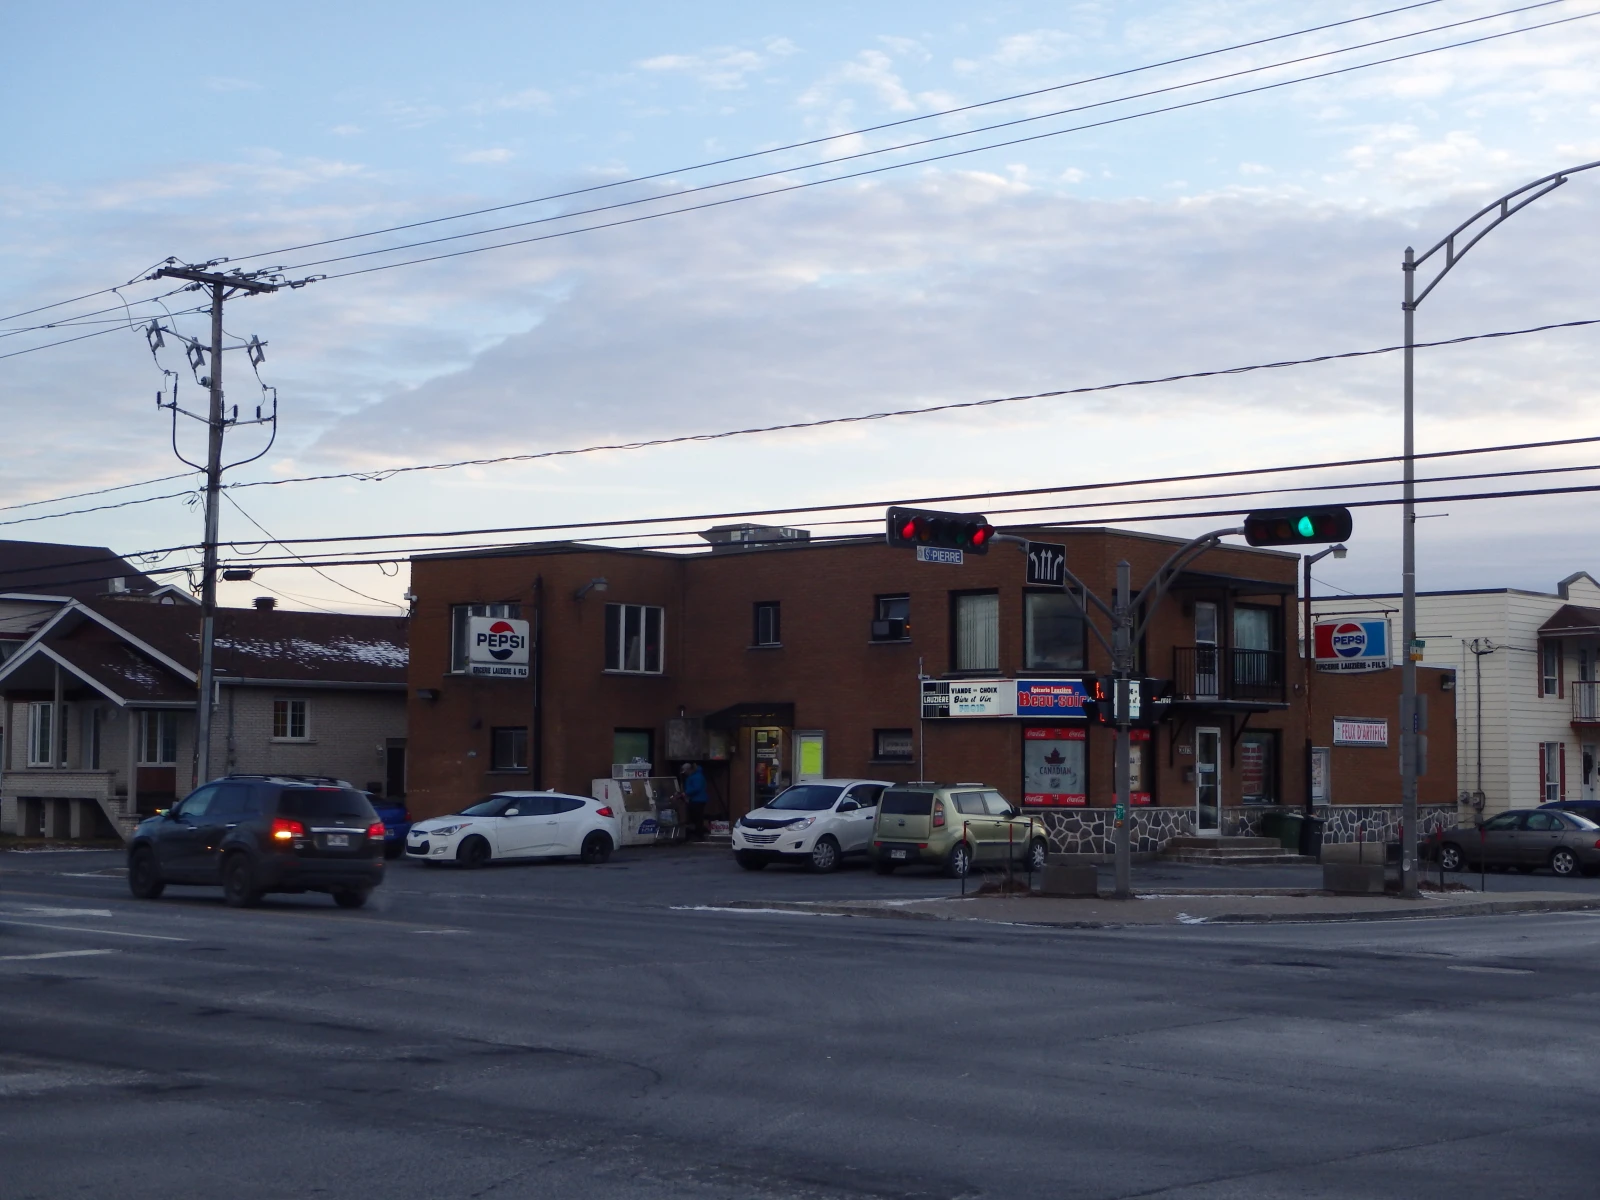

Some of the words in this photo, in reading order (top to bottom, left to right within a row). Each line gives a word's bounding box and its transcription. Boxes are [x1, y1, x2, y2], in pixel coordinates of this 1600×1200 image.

[477, 633, 525, 649] PEPSI
[1333, 635, 1365, 646] PEPSI
[1372, 661, 1386, 669] FILS
[1342, 724, 1355, 739] FEUX
[635, 770, 647, 778] ICE
[1040, 766, 1072, 775] CANADIAN
